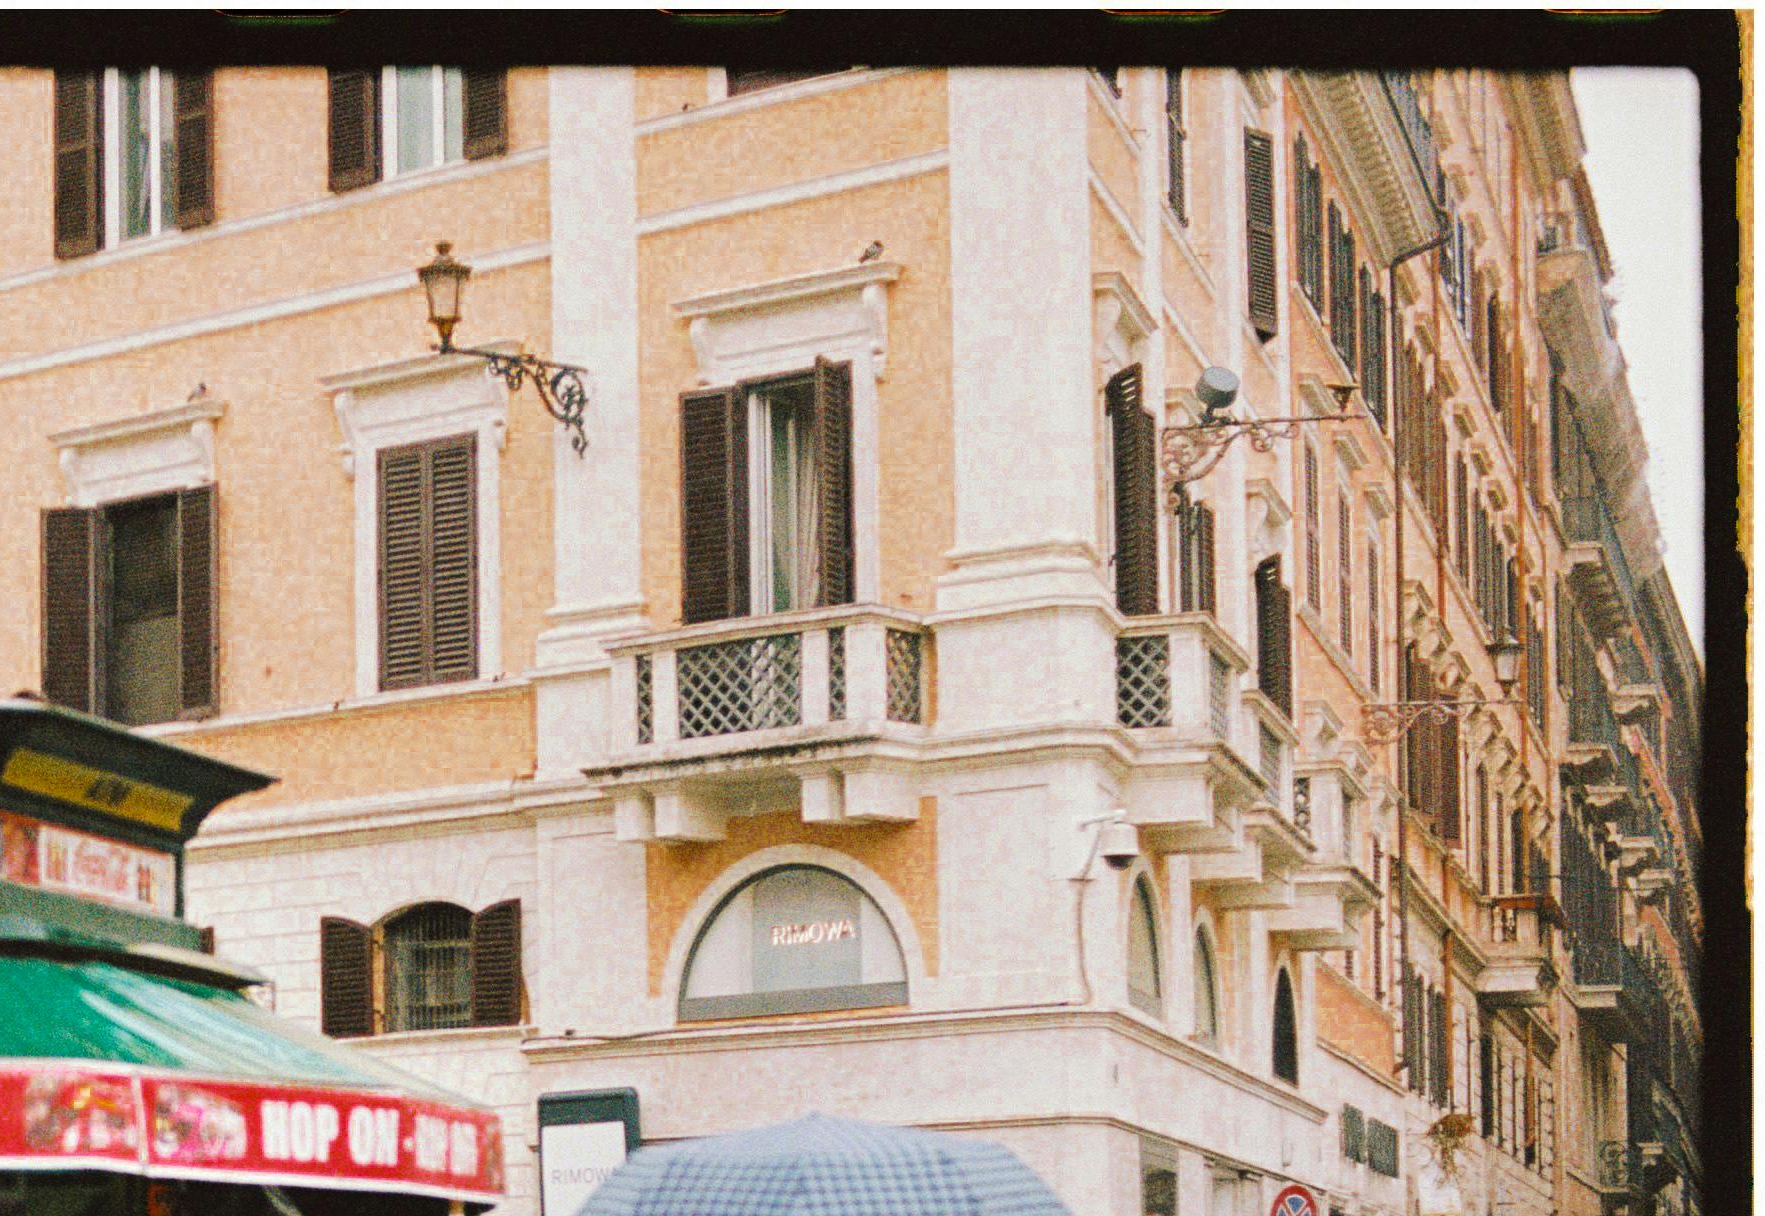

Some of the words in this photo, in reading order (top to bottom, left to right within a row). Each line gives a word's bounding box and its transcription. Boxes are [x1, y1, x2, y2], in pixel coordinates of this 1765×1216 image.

[771, 919, 856, 946] RIMOWA
[261, 1099, 340, 1163] HOP
[348, 1105, 400, 1168] ON
